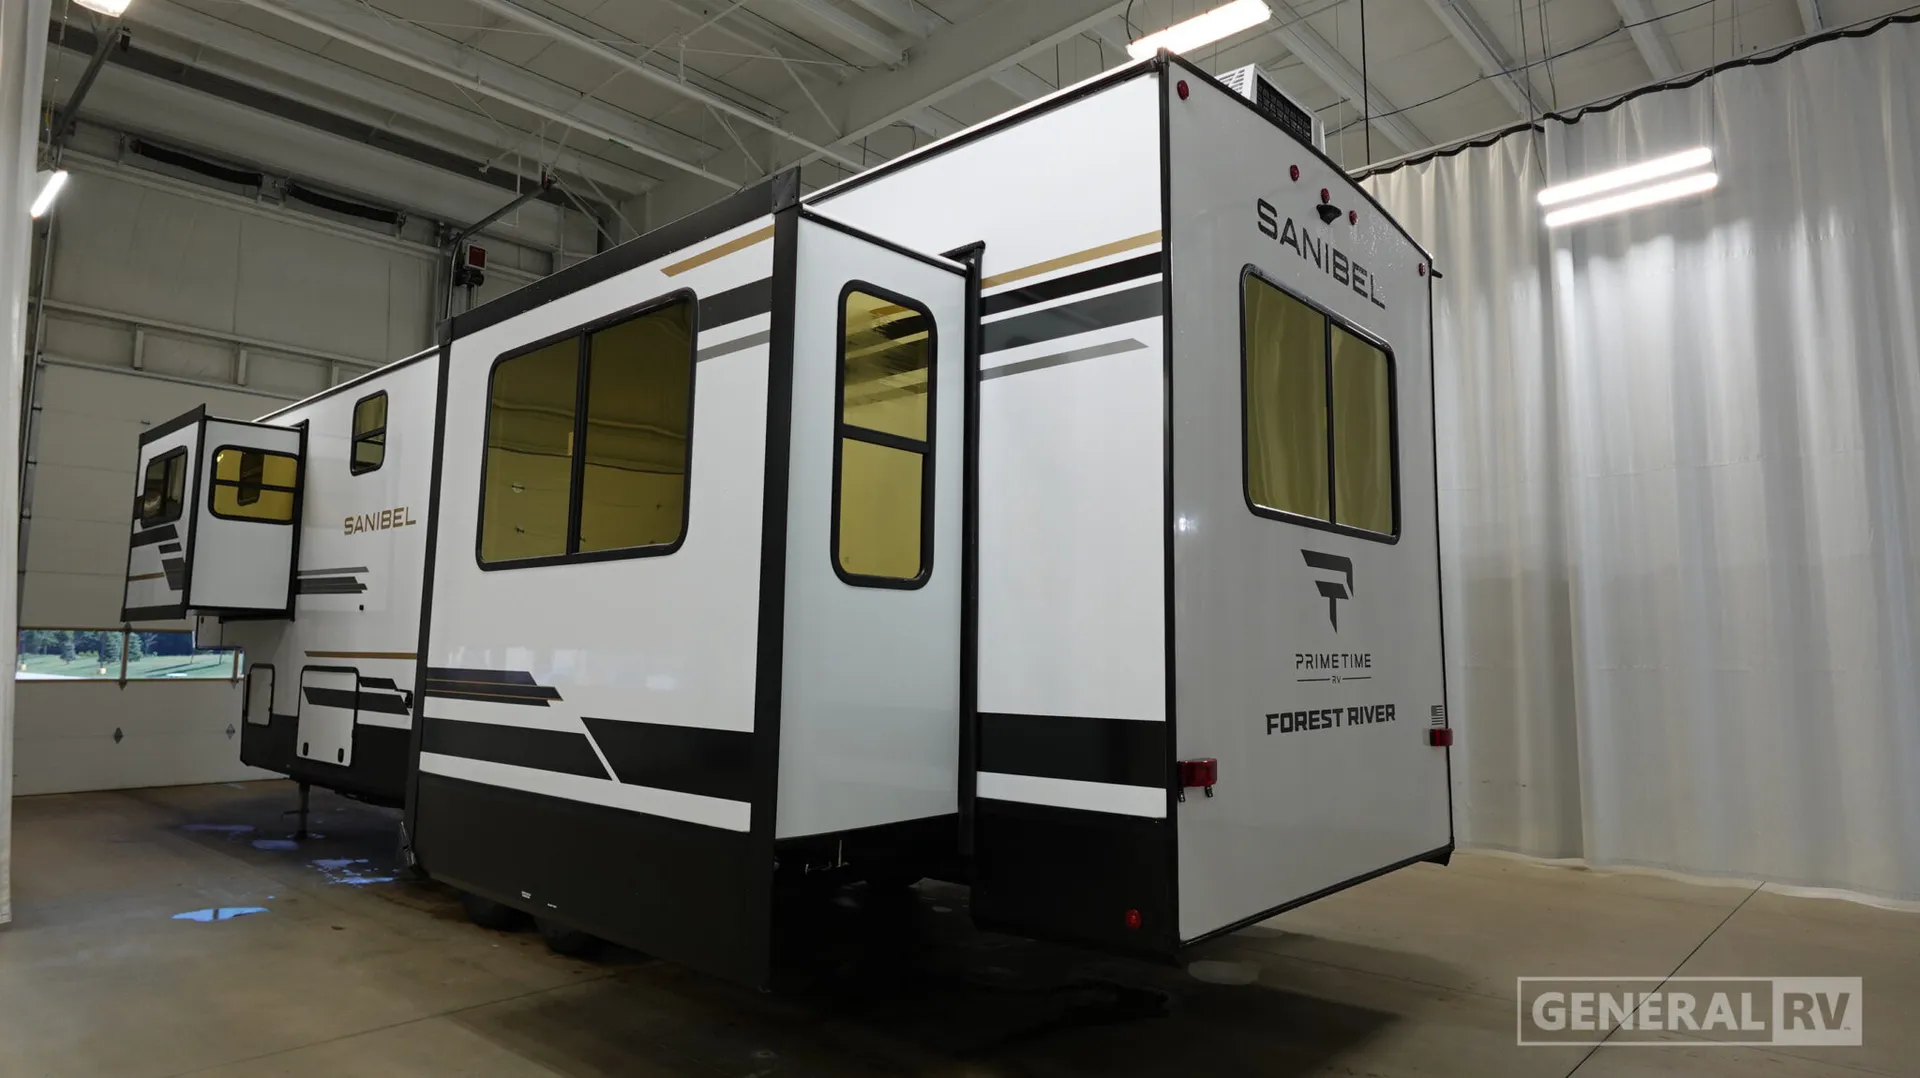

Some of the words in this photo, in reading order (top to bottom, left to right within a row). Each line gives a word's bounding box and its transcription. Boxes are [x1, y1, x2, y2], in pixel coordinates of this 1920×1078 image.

[1257, 198, 1386, 310] SANIBEL
[343, 506, 417, 535] SANIBEL
[1295, 653, 1372, 670] PRIMETIME
[1331, 675, 1342, 684] RV
[1265, 708, 1344, 735] FOREST
[1347, 703, 1396, 727] RIVER
